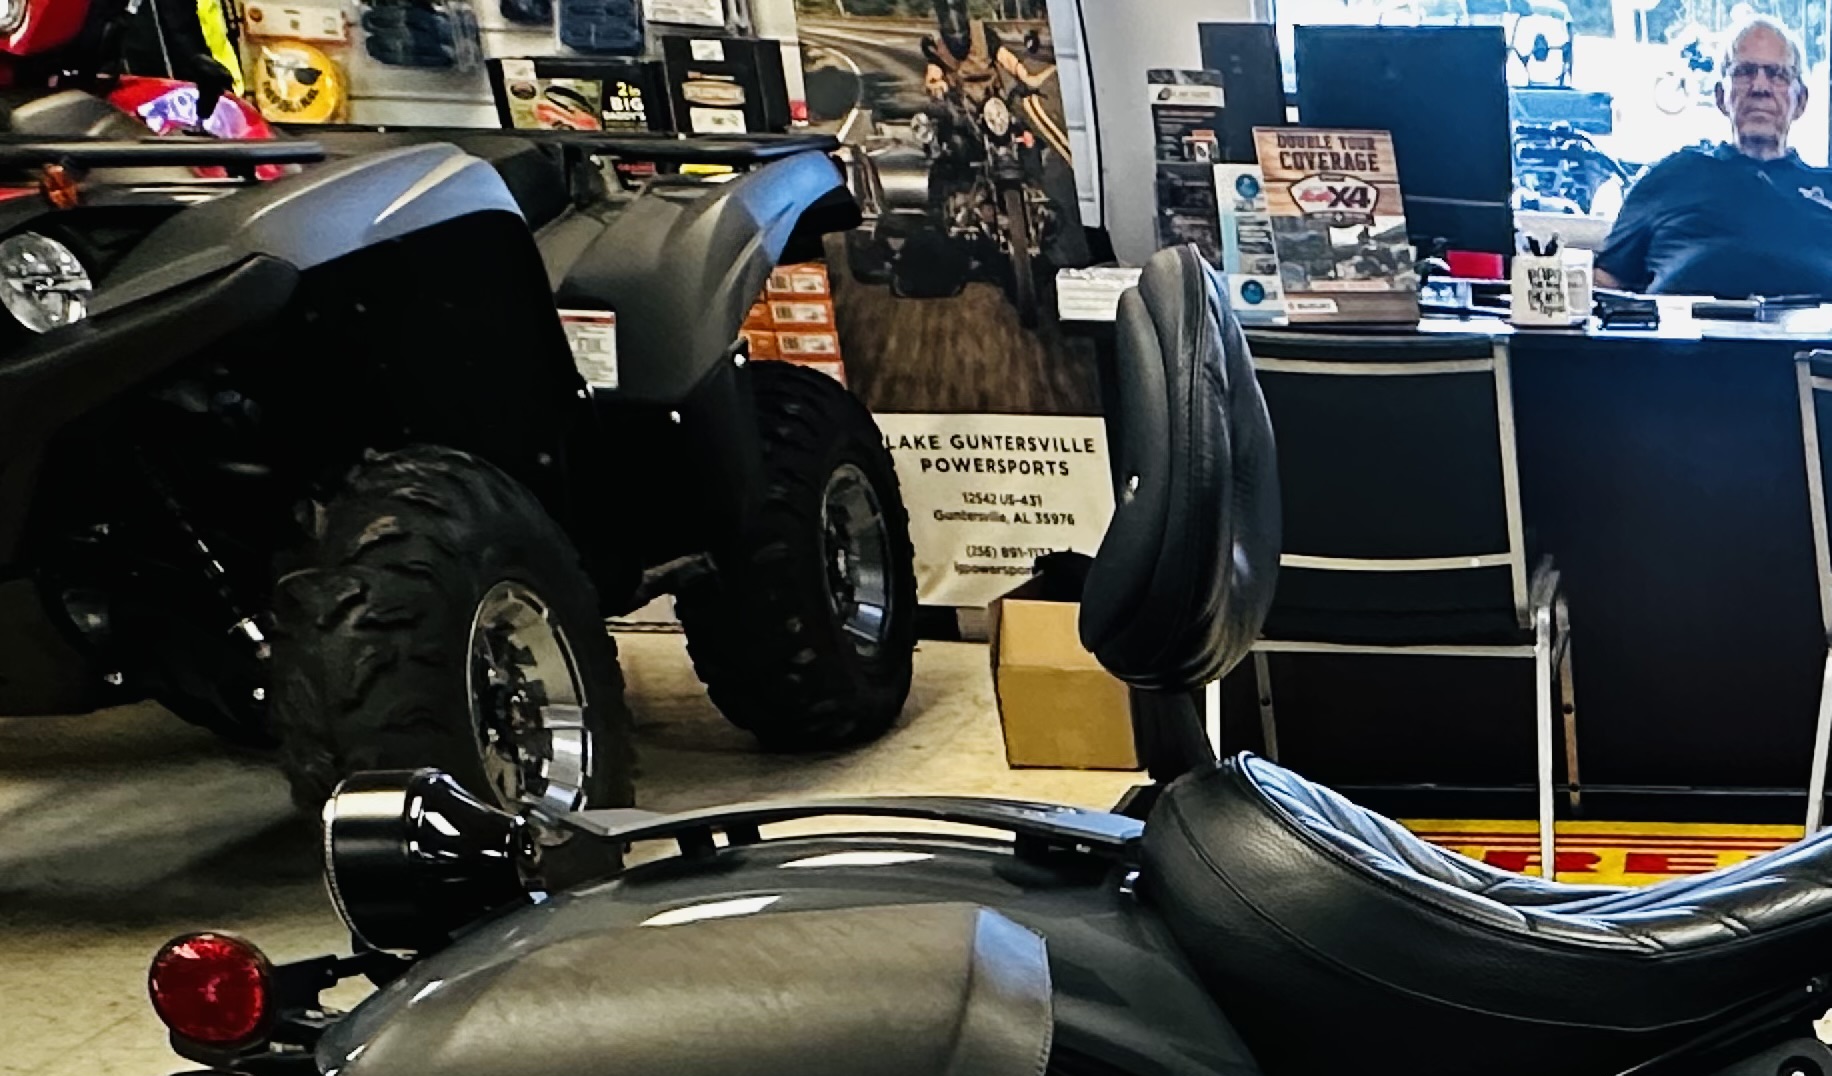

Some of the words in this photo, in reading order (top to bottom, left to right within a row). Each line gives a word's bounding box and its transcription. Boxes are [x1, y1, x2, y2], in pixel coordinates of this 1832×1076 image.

[1279, 151, 1381, 172] COVERAGE
[885, 434, 942, 450] LAKE
[950, 434, 1096, 453] GUNTERSVILLE
[920, 457, 1070, 476] POWERSPORTS
[962, 492, 997, 505] 12542
[1000, 493, 1043, 508] US-431
[1014, 512, 1032, 524] AL
